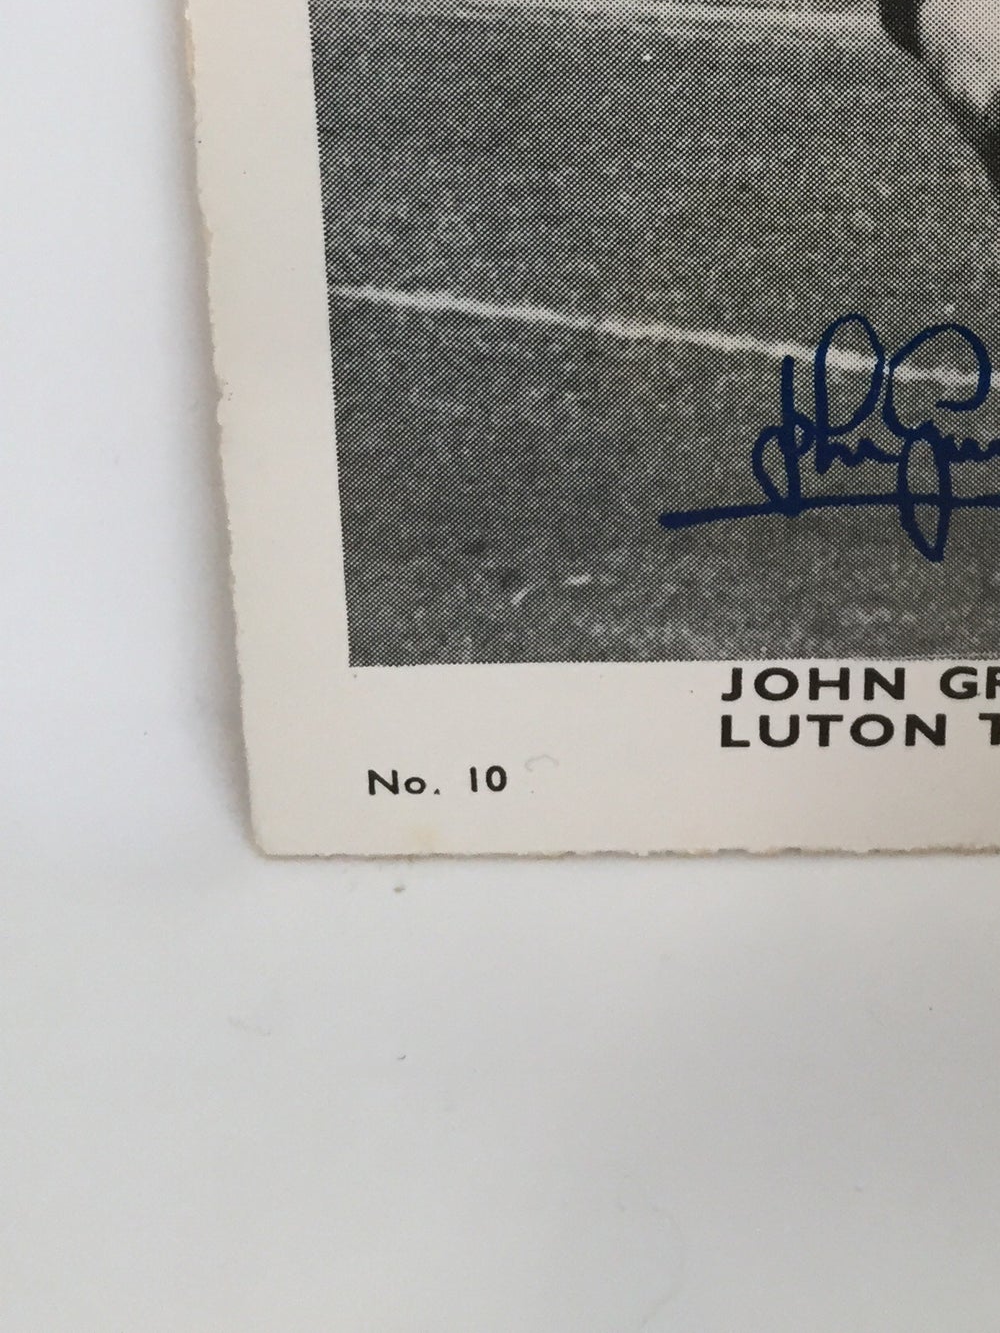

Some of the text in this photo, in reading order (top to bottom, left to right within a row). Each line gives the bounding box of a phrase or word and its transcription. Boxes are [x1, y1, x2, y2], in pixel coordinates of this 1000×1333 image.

[721, 666, 907, 702] JOHN
[720, 713, 947, 748] LUTON
[367, 765, 508, 796] No. 10
